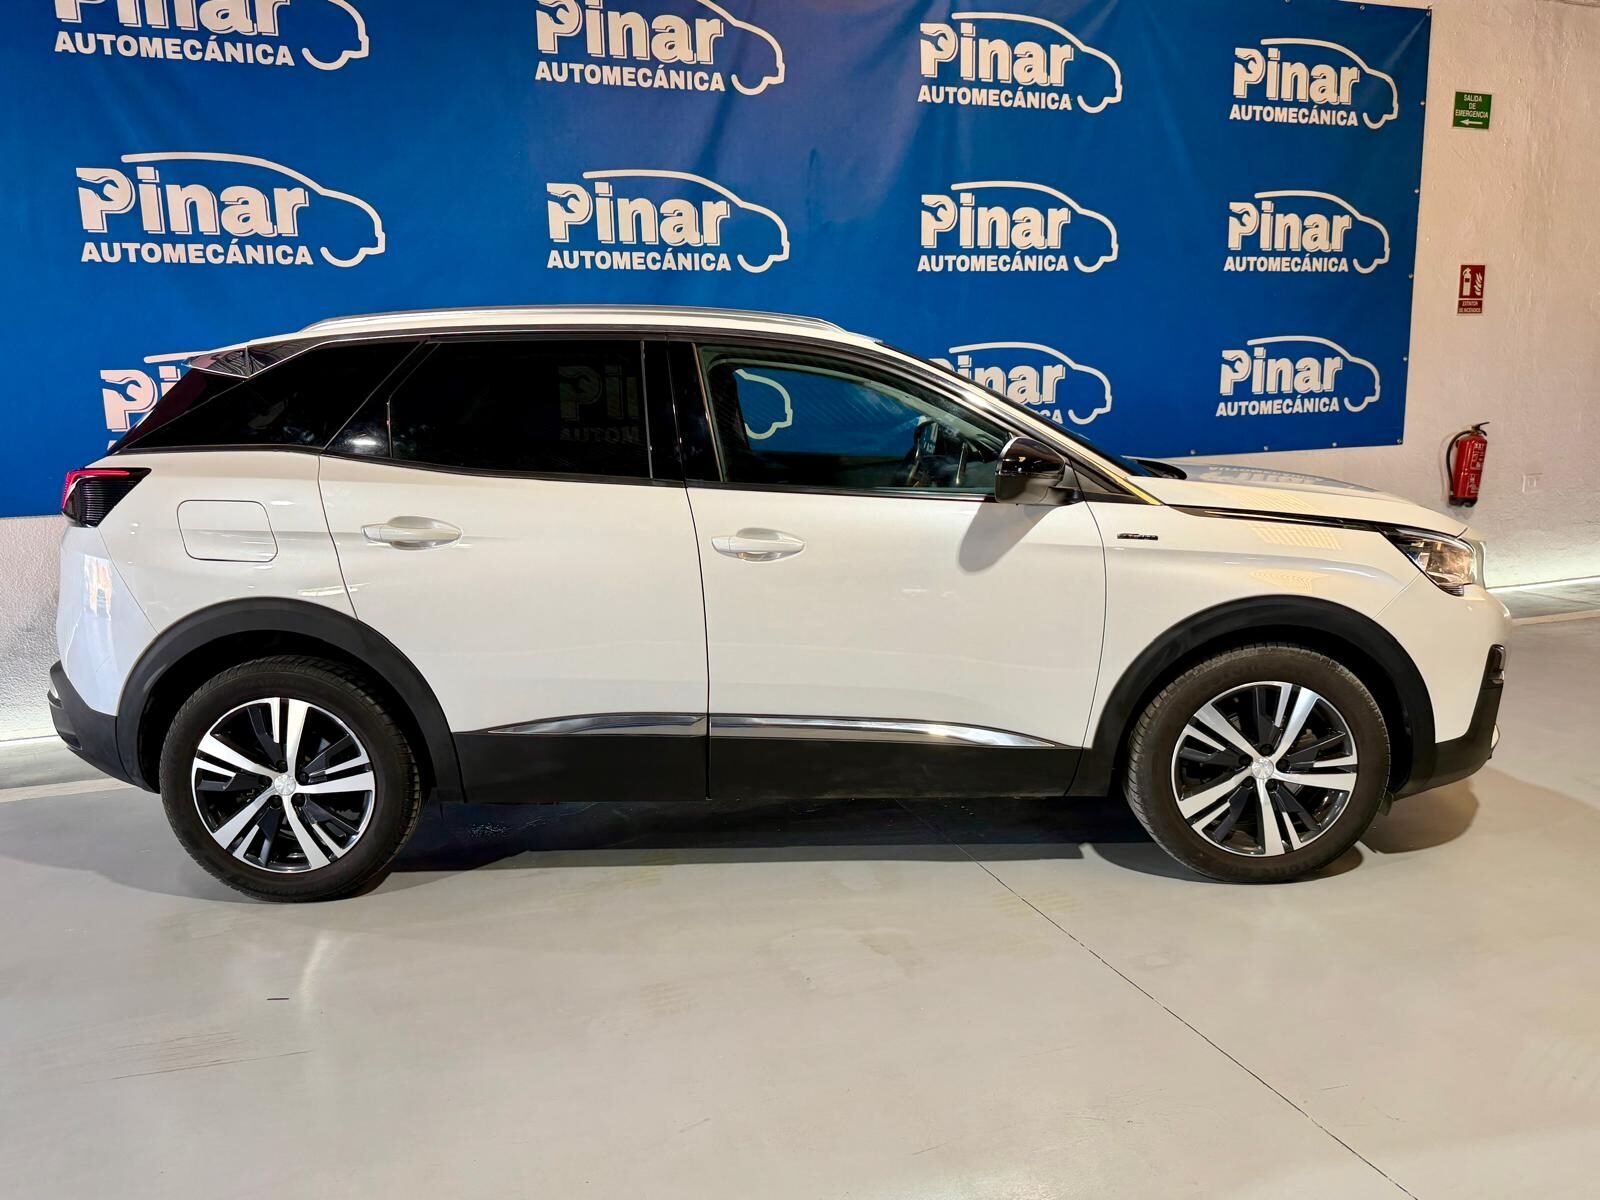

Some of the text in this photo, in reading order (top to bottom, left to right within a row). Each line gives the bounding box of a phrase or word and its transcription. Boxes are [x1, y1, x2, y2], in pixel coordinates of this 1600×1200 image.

[54, 30, 295, 66] AUTOMECÁNICA
[536, 0, 724, 65] Pinar
[920, 22, 1074, 87] Pinar
[535, 61, 725, 92] AUTOMECÁNICA
[1233, 48, 1360, 105] Pinar
[918, 85, 1072, 110] AUTOMECÁNICA
[1464, 94, 1482, 102] SALIDA
[1229, 104, 1358, 127] AUTOMECÁNICA
[76, 166, 309, 238] Pinar
[547, 182, 730, 247] Pinar
[921, 193, 1071, 249] Pinar
[1228, 200, 1352, 252] Pinar
[81, 239, 313, 266] AUTOMECÁNICA
[547, 248, 731, 271] AUTOMECÁNICA
[917, 251, 1069, 272] AUTOMECÁNICA
[1224, 254, 1349, 273] AUTOMECÁNICA
[1220, 347, 1343, 395] Pinar
[1216, 395, 1340, 417] AUTOMECÁNICA
